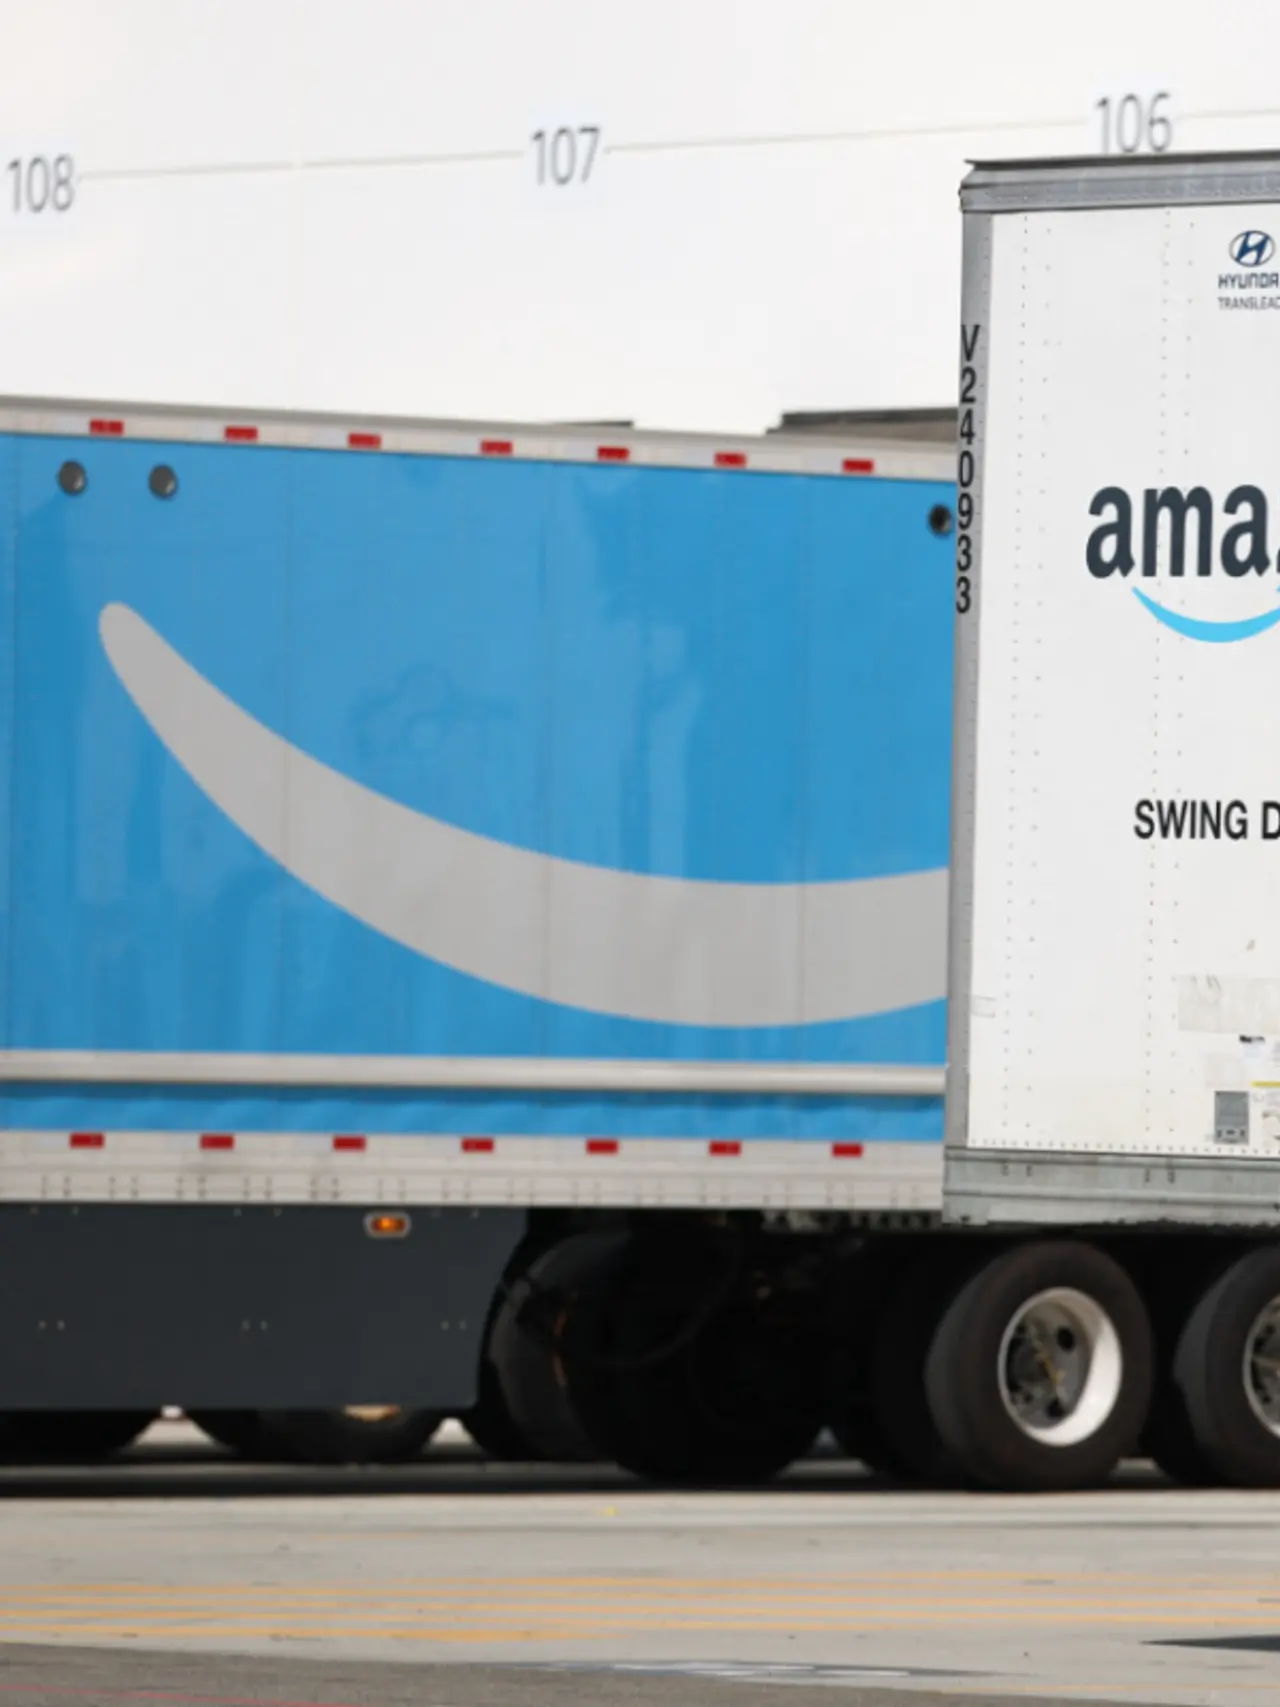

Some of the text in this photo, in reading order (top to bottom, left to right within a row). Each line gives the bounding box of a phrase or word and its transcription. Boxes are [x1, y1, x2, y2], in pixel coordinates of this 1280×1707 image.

[1096, 92, 1172, 153] 106
[7, 154, 76, 214] 108
[531, 125, 601, 187] 107
[956, 324, 981, 614] V240933
[1134, 799, 1248, 840] SWING
